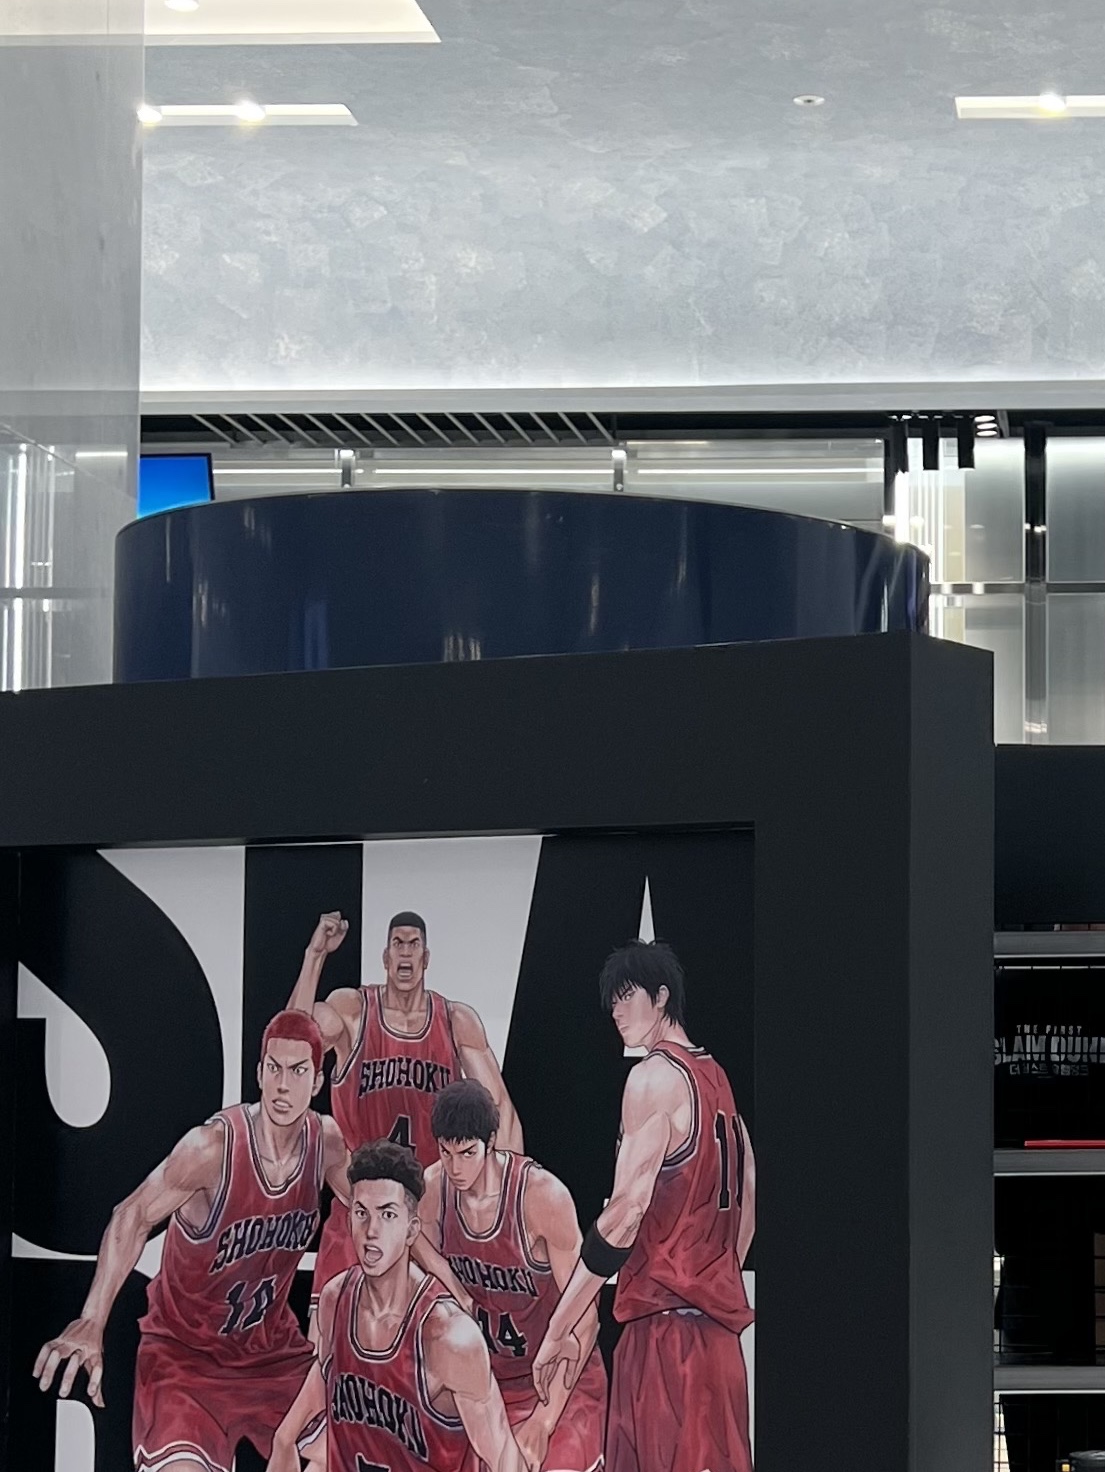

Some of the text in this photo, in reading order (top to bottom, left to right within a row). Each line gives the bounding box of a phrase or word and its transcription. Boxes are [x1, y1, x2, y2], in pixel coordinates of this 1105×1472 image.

[1017, 1024, 1083, 1035] THE FIRST
[358, 1055, 451, 1099] SHOHOKU
[217, 1274, 277, 1336] 10
[476, 1304, 528, 1357] 14
